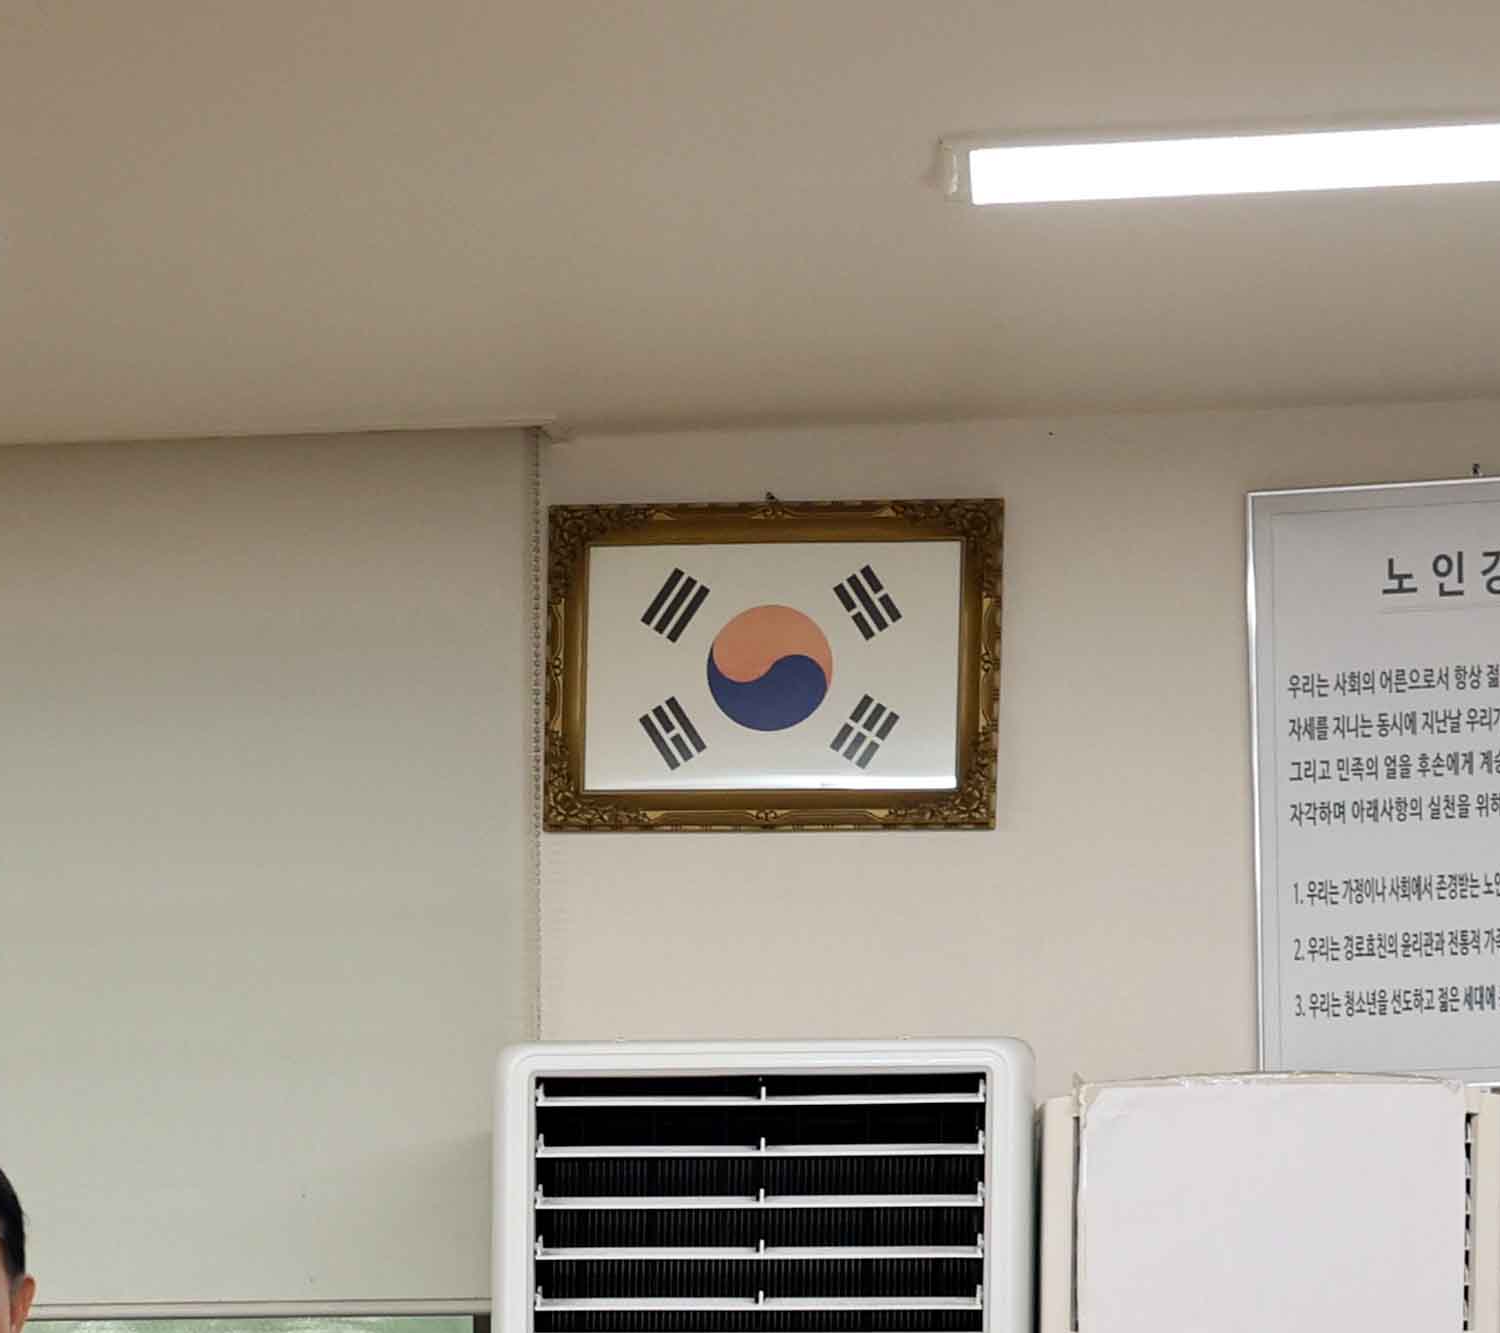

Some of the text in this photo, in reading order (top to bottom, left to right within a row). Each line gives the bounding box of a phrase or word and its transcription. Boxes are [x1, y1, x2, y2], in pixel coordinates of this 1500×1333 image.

[1287, 673, 1330, 699] 우리는
[1333, 671, 1376, 696] 사회의
[1380, 667, 1449, 694] 어른으로서
[1454, 666, 1482, 690] 항상
[1288, 717, 1329, 742] 자세를
[1332, 714, 1373, 739] 지니는
[1375, 711, 1418, 738] 동시에
[1421, 709, 1462, 735] 지난날
[1289, 759, 1331, 784] 그리고
[1336, 756, 1379, 782] 민족의
[1384, 754, 1412, 779] 얼을
[1417, 751, 1474, 777] 후손에게
[1290, 800, 1346, 826] 자각하며
[1351, 796, 1422, 823] 아래사항의
[1428, 794, 1471, 820] 실천을
